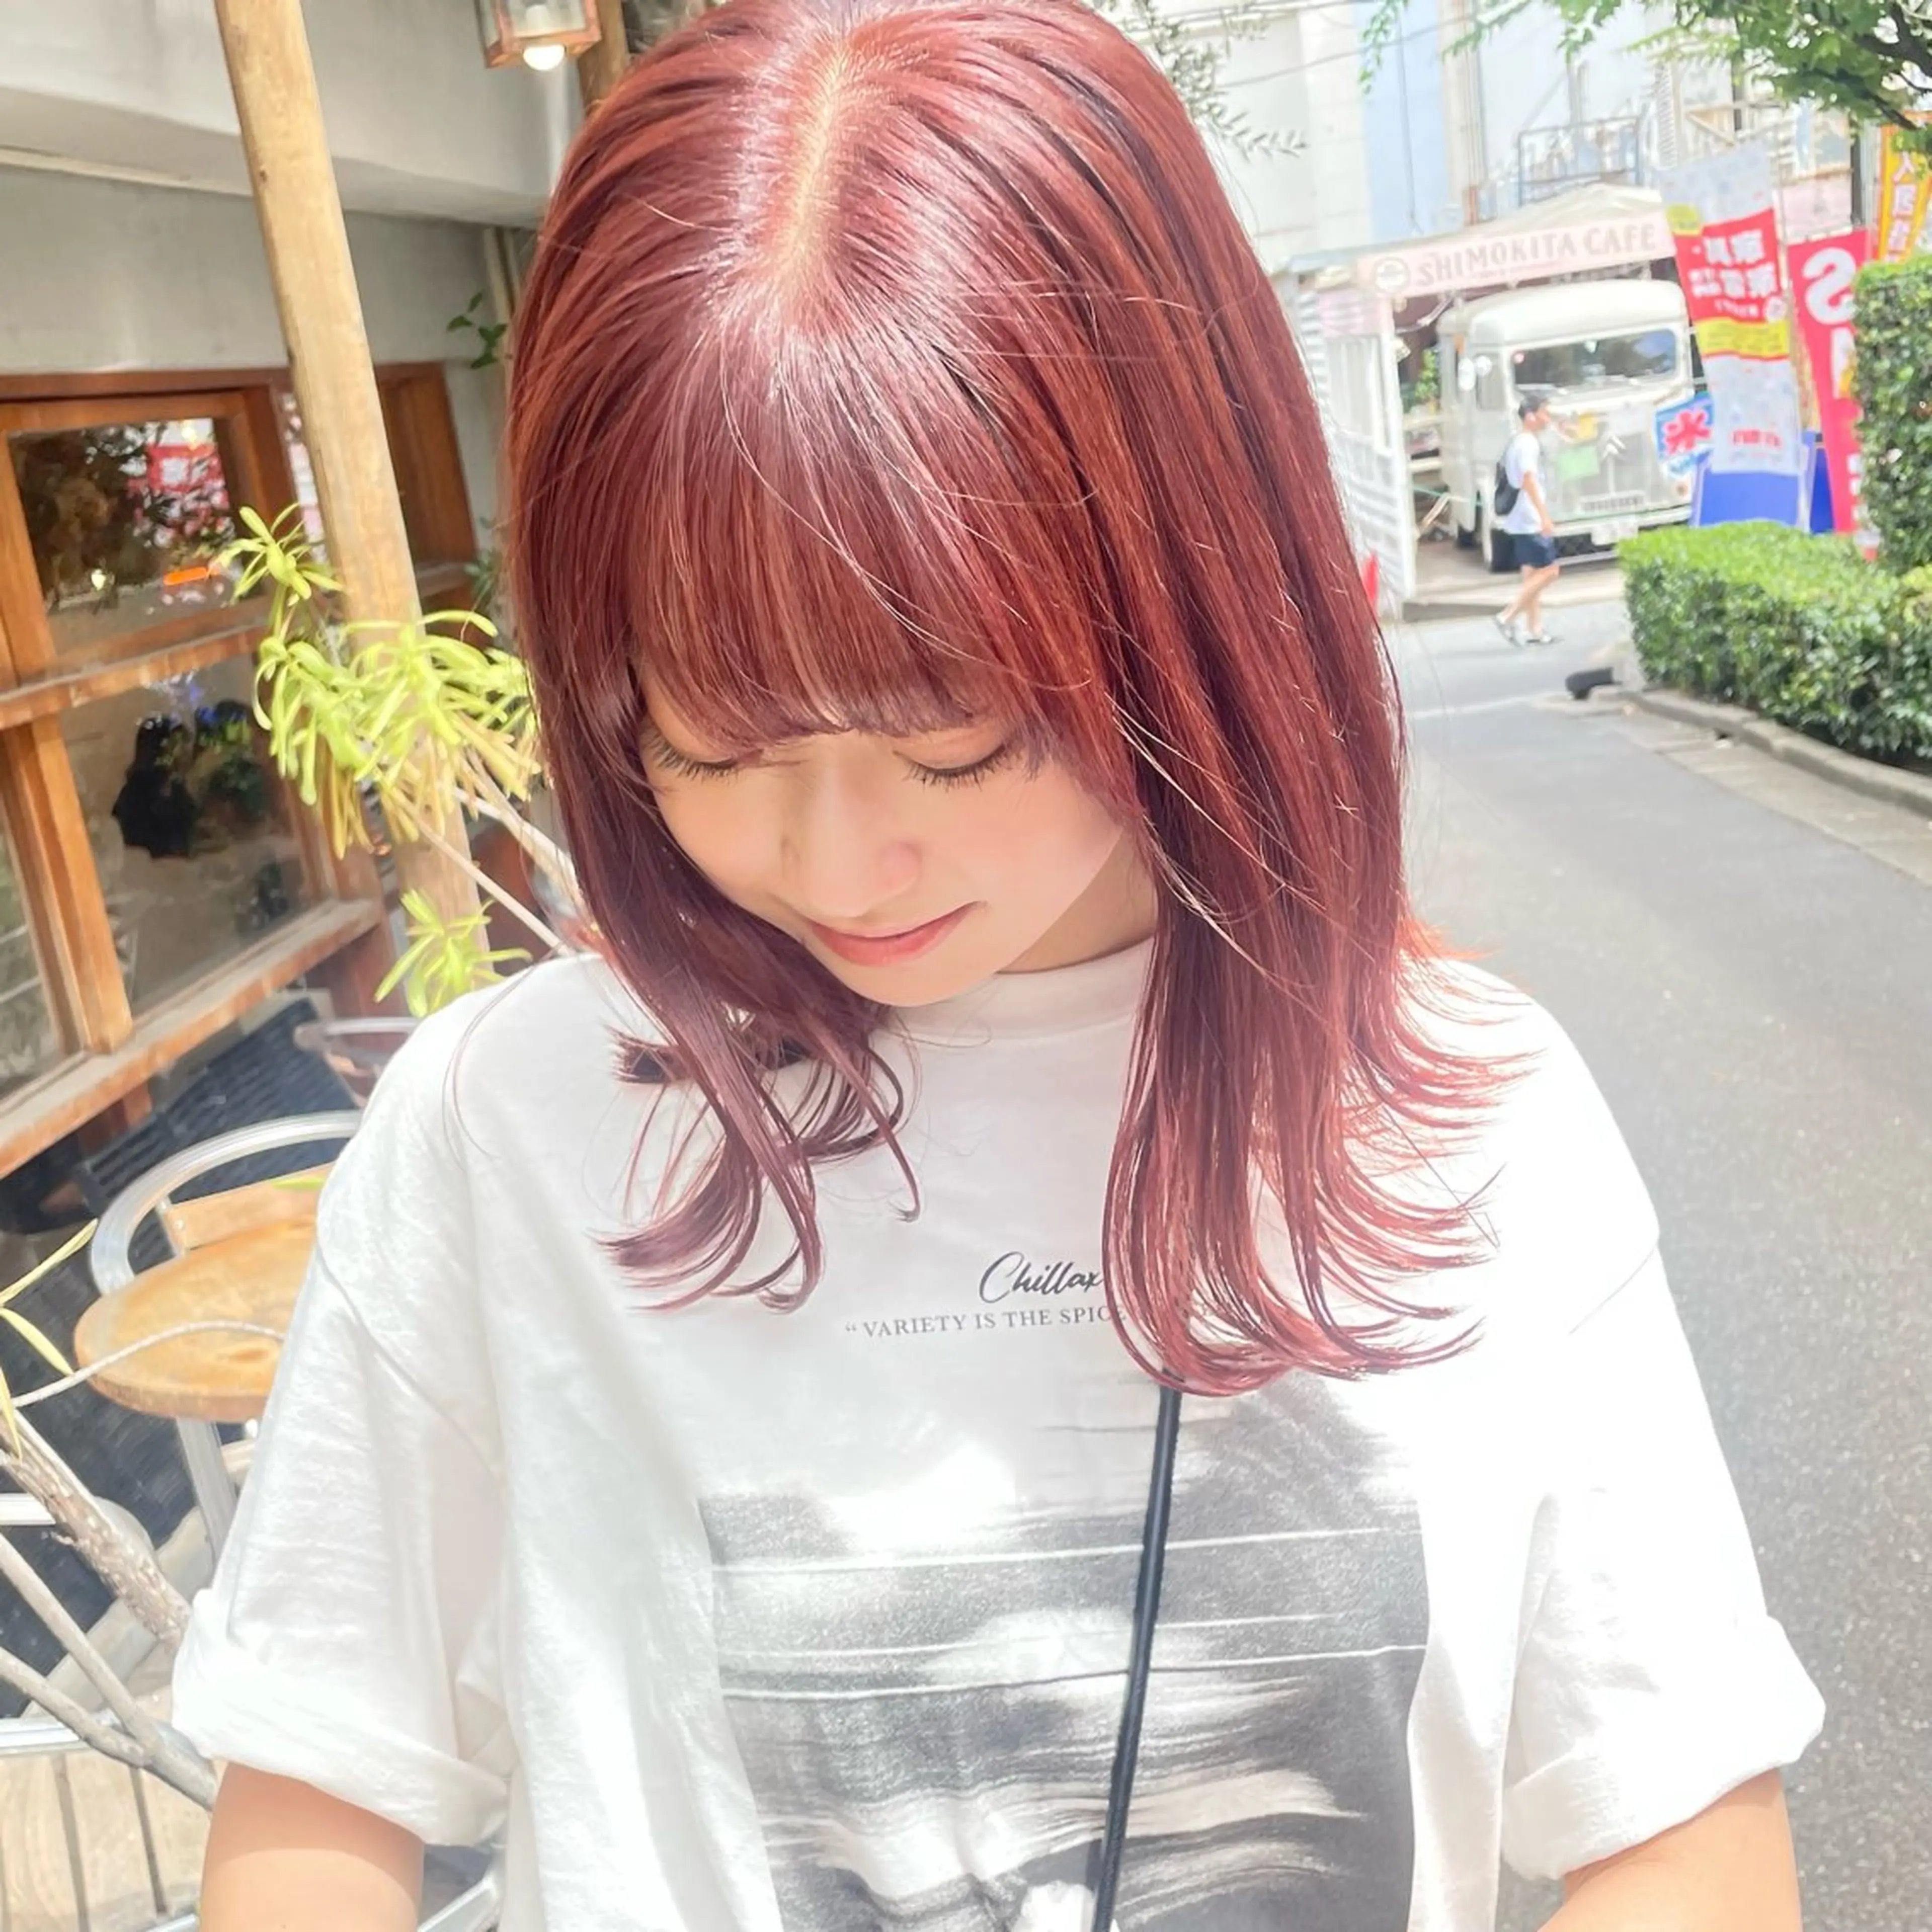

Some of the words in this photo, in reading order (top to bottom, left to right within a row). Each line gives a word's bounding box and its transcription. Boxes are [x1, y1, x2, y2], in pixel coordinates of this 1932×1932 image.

[1418, 232, 1577, 286] SHIMOKITA
[1583, 222, 1655, 255] CAFE
[979, 1251, 1104, 1303] Chillax
[976, 1313, 996, 1330] IS
[1002, 1309, 1053, 1328] THE
